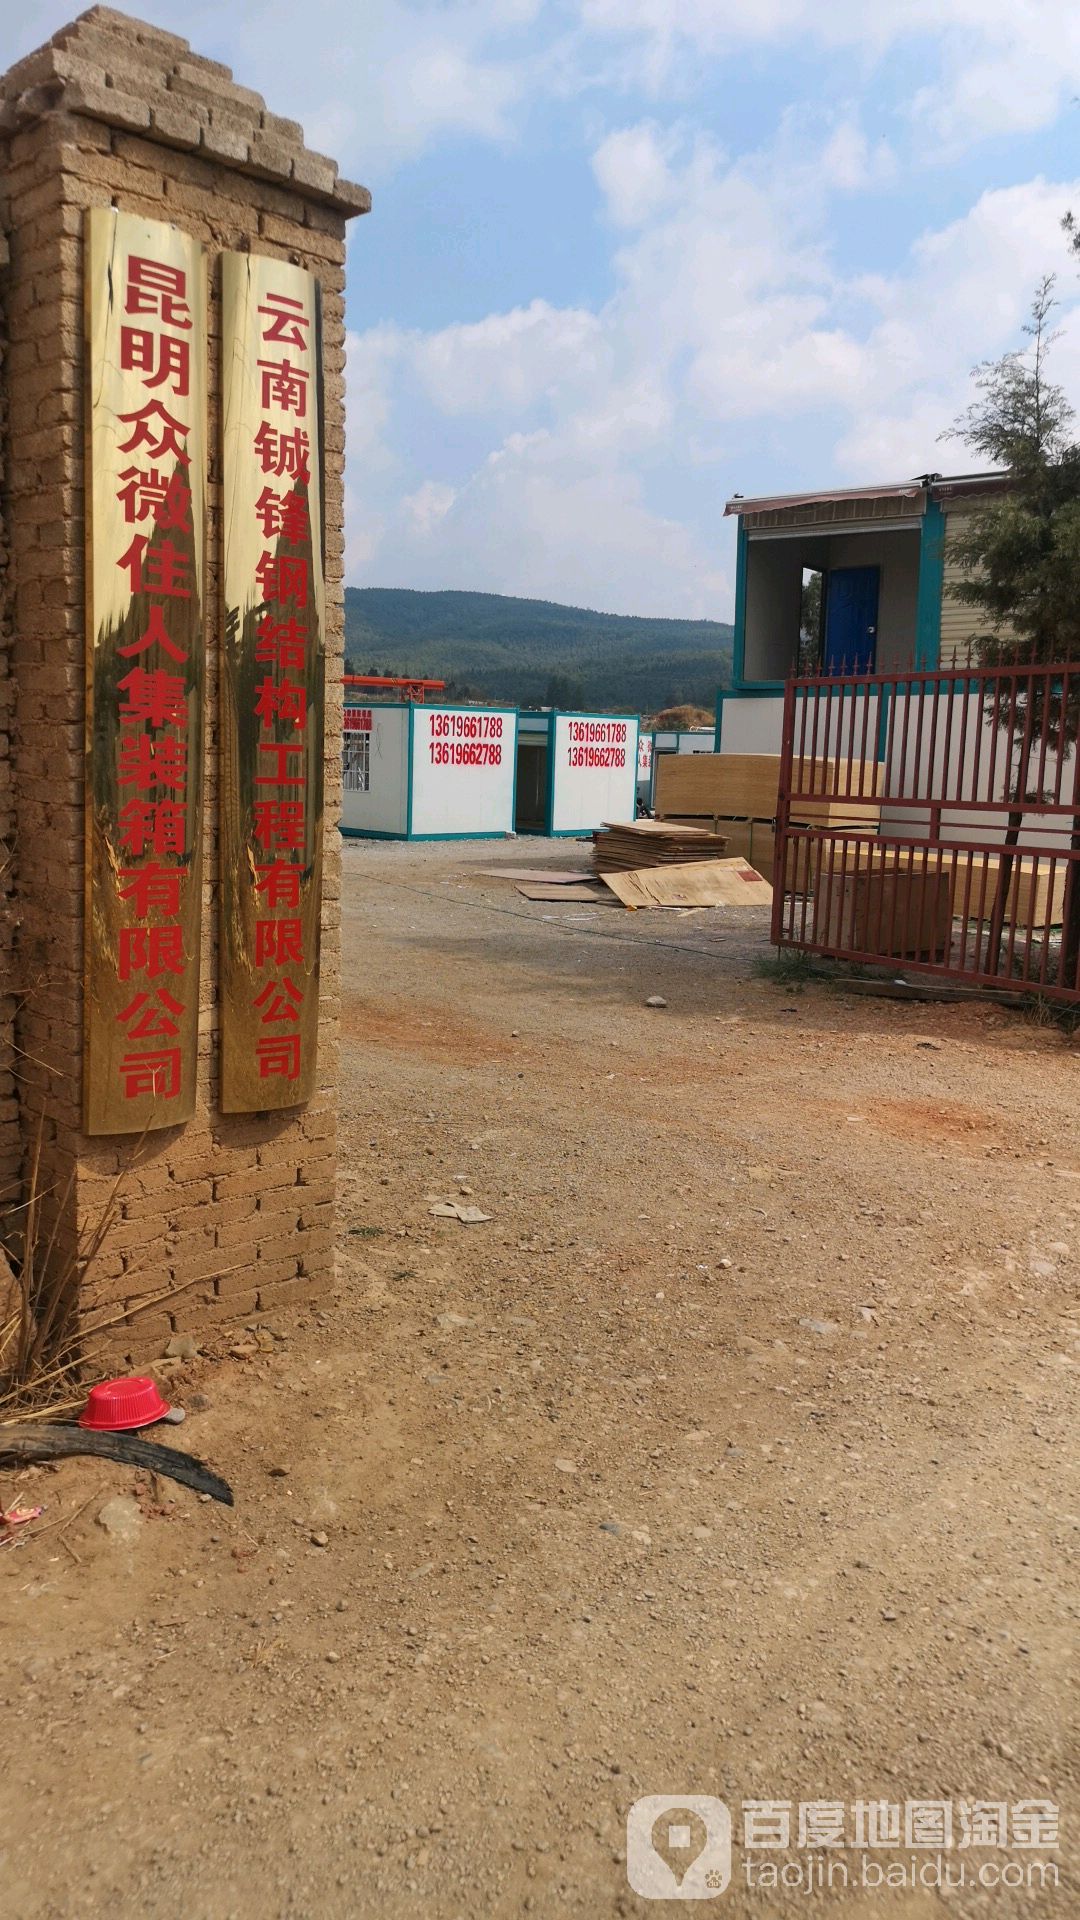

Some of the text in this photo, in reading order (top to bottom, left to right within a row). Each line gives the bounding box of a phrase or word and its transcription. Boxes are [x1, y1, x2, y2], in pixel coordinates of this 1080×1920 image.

[116, 254, 194, 1100] 昆明众微住人集装箱有限公司
[253, 291, 311, 1081] 云南铖锋钢结构工程有限公司
[429, 714, 503, 738] 13619661788
[568, 721, 627, 743] 13619661788
[428, 742, 502, 765] 13619662788
[567, 746, 626, 768] 13619662788
